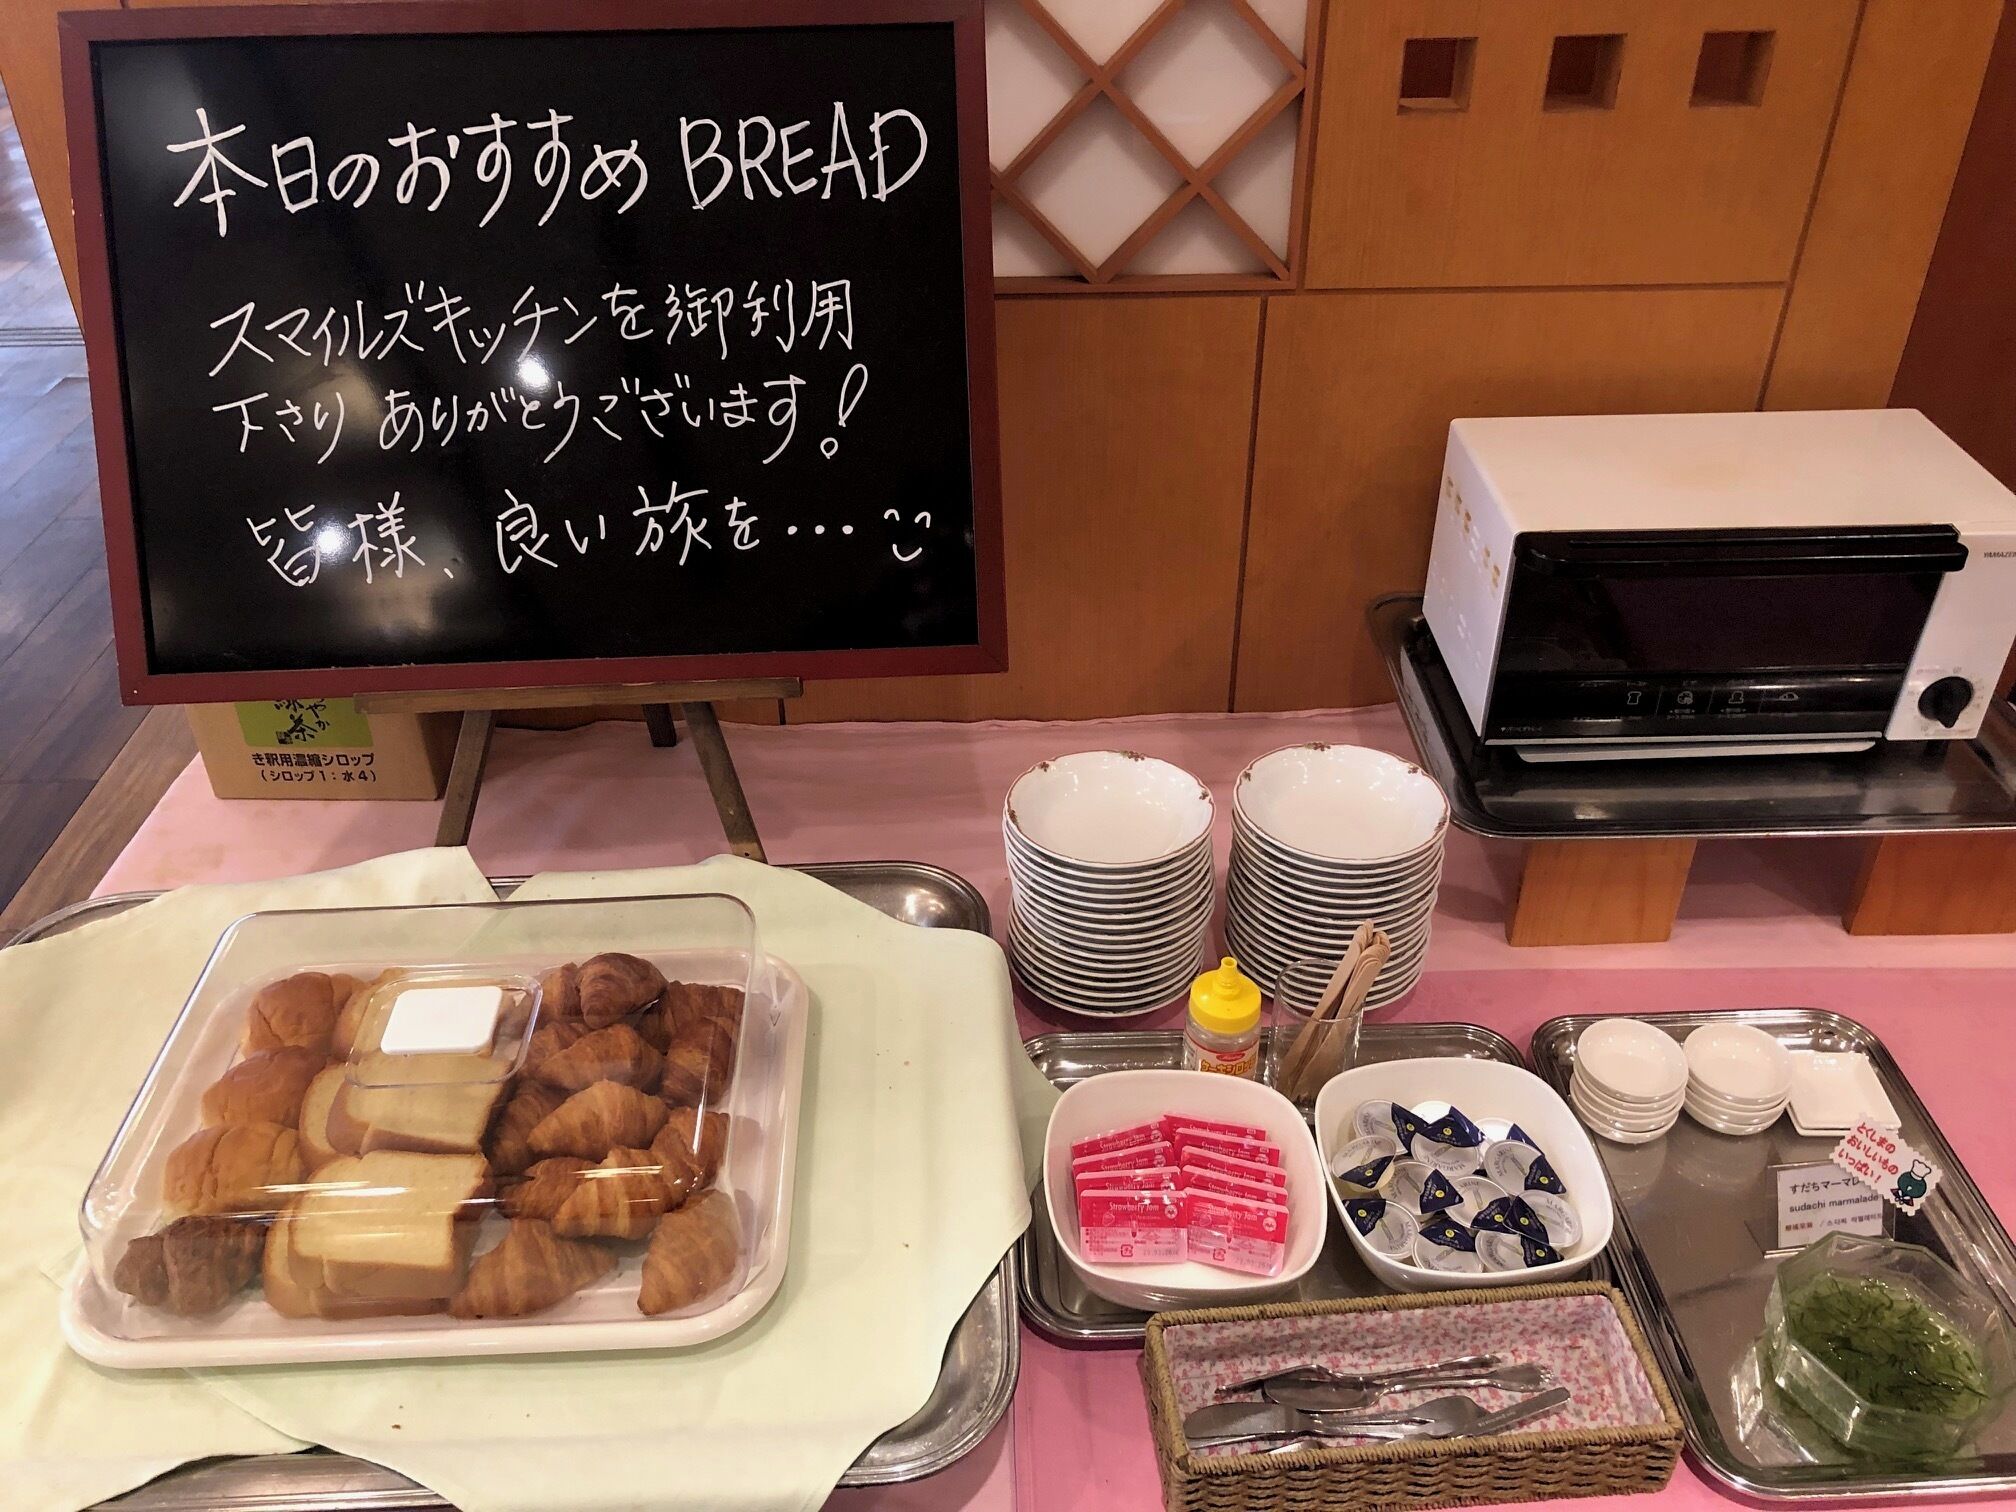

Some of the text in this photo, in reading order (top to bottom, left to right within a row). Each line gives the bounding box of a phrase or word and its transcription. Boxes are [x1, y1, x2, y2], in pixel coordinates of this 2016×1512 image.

[166, 101, 929, 237] 本日のおすすめ BREAD
[212, 363, 869, 465] 下さり ありがとうございます！
[1857, 1122, 1896, 1154] とくしまの
[1136, 1157, 1149, 1166] Jam
[1838, 1148, 1882, 1184] いっぱい！
[1847, 1135, 1899, 1175] おいしいもの
[1110, 1201, 1159, 1214] Strawberry Jam
[1244, 1211, 1258, 1220] Jam
[1789, 1194, 1879, 1213] sudachi marmalade
